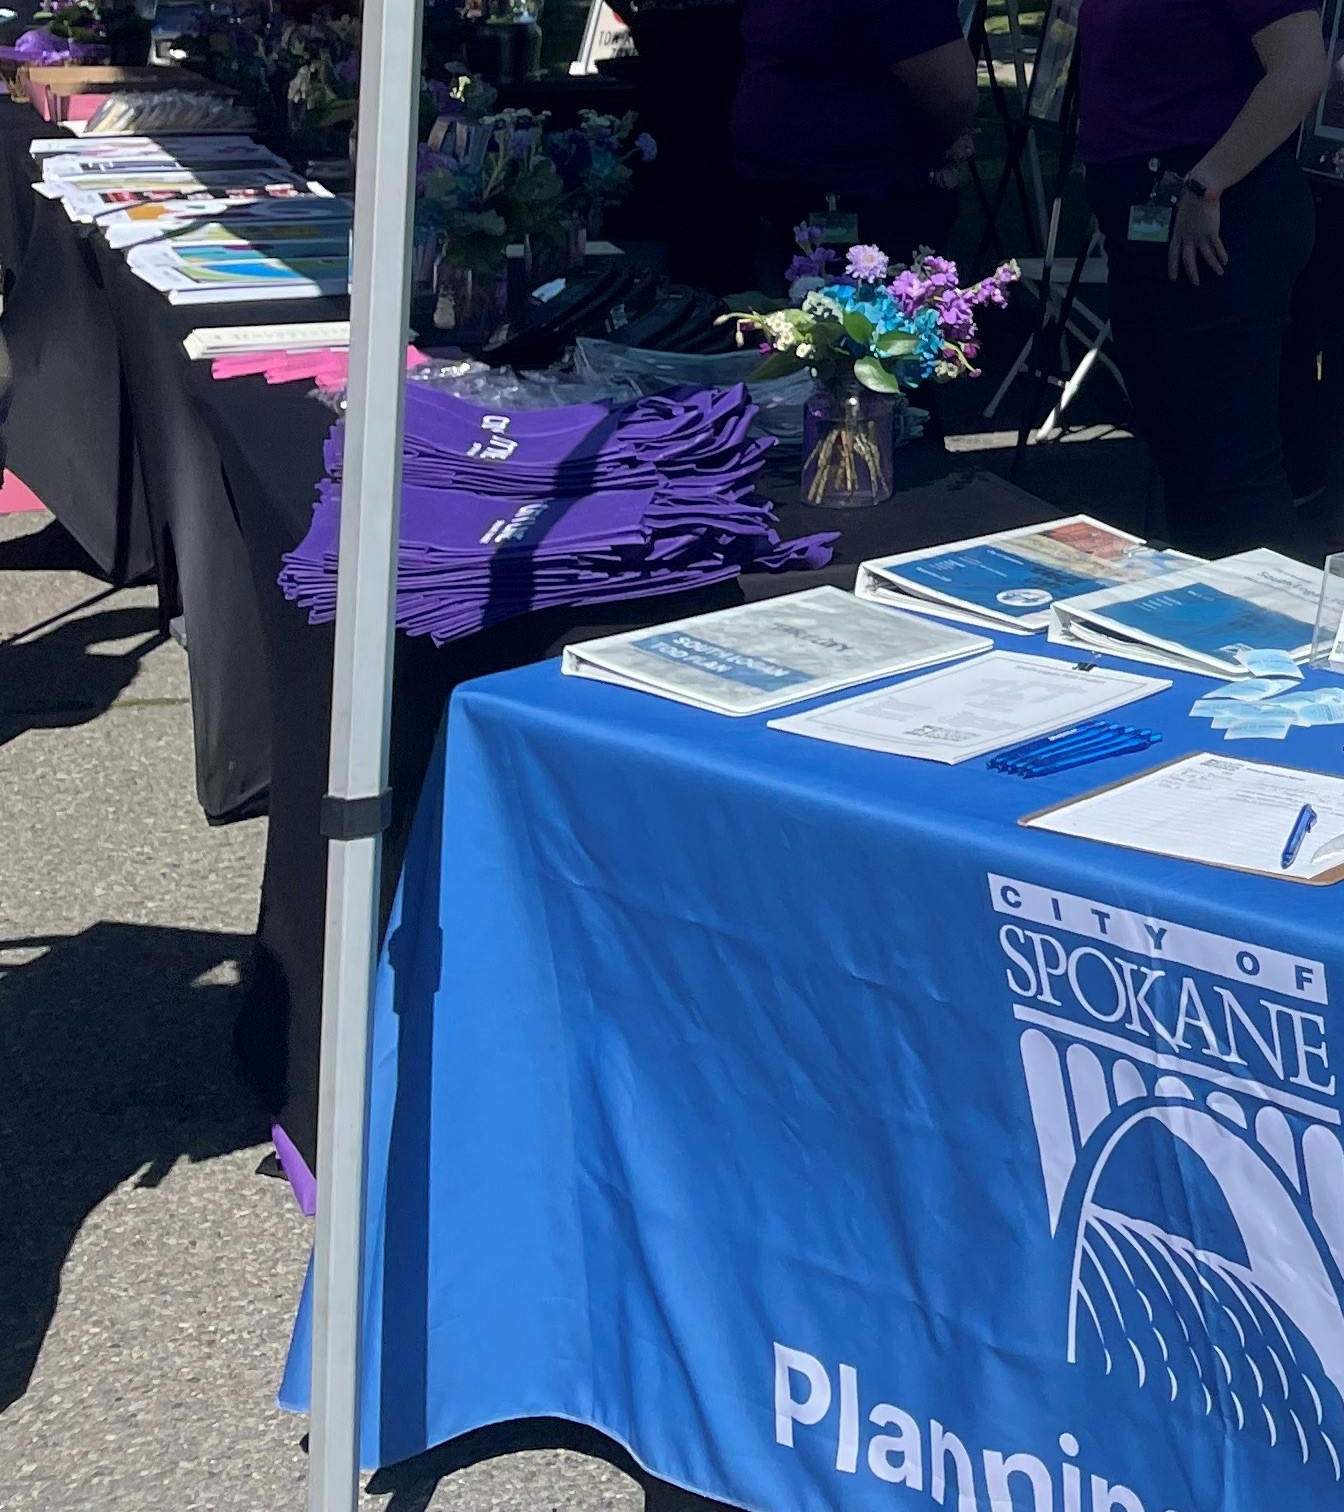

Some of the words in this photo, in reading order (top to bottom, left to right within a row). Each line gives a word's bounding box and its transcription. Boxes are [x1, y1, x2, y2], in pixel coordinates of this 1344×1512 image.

[999, 924, 1337, 1095] SPOKANE
[1000, 883, 1168, 951] CITY
[1235, 950, 1315, 991] OF
[773, 1341, 1178, 1511] Planni
